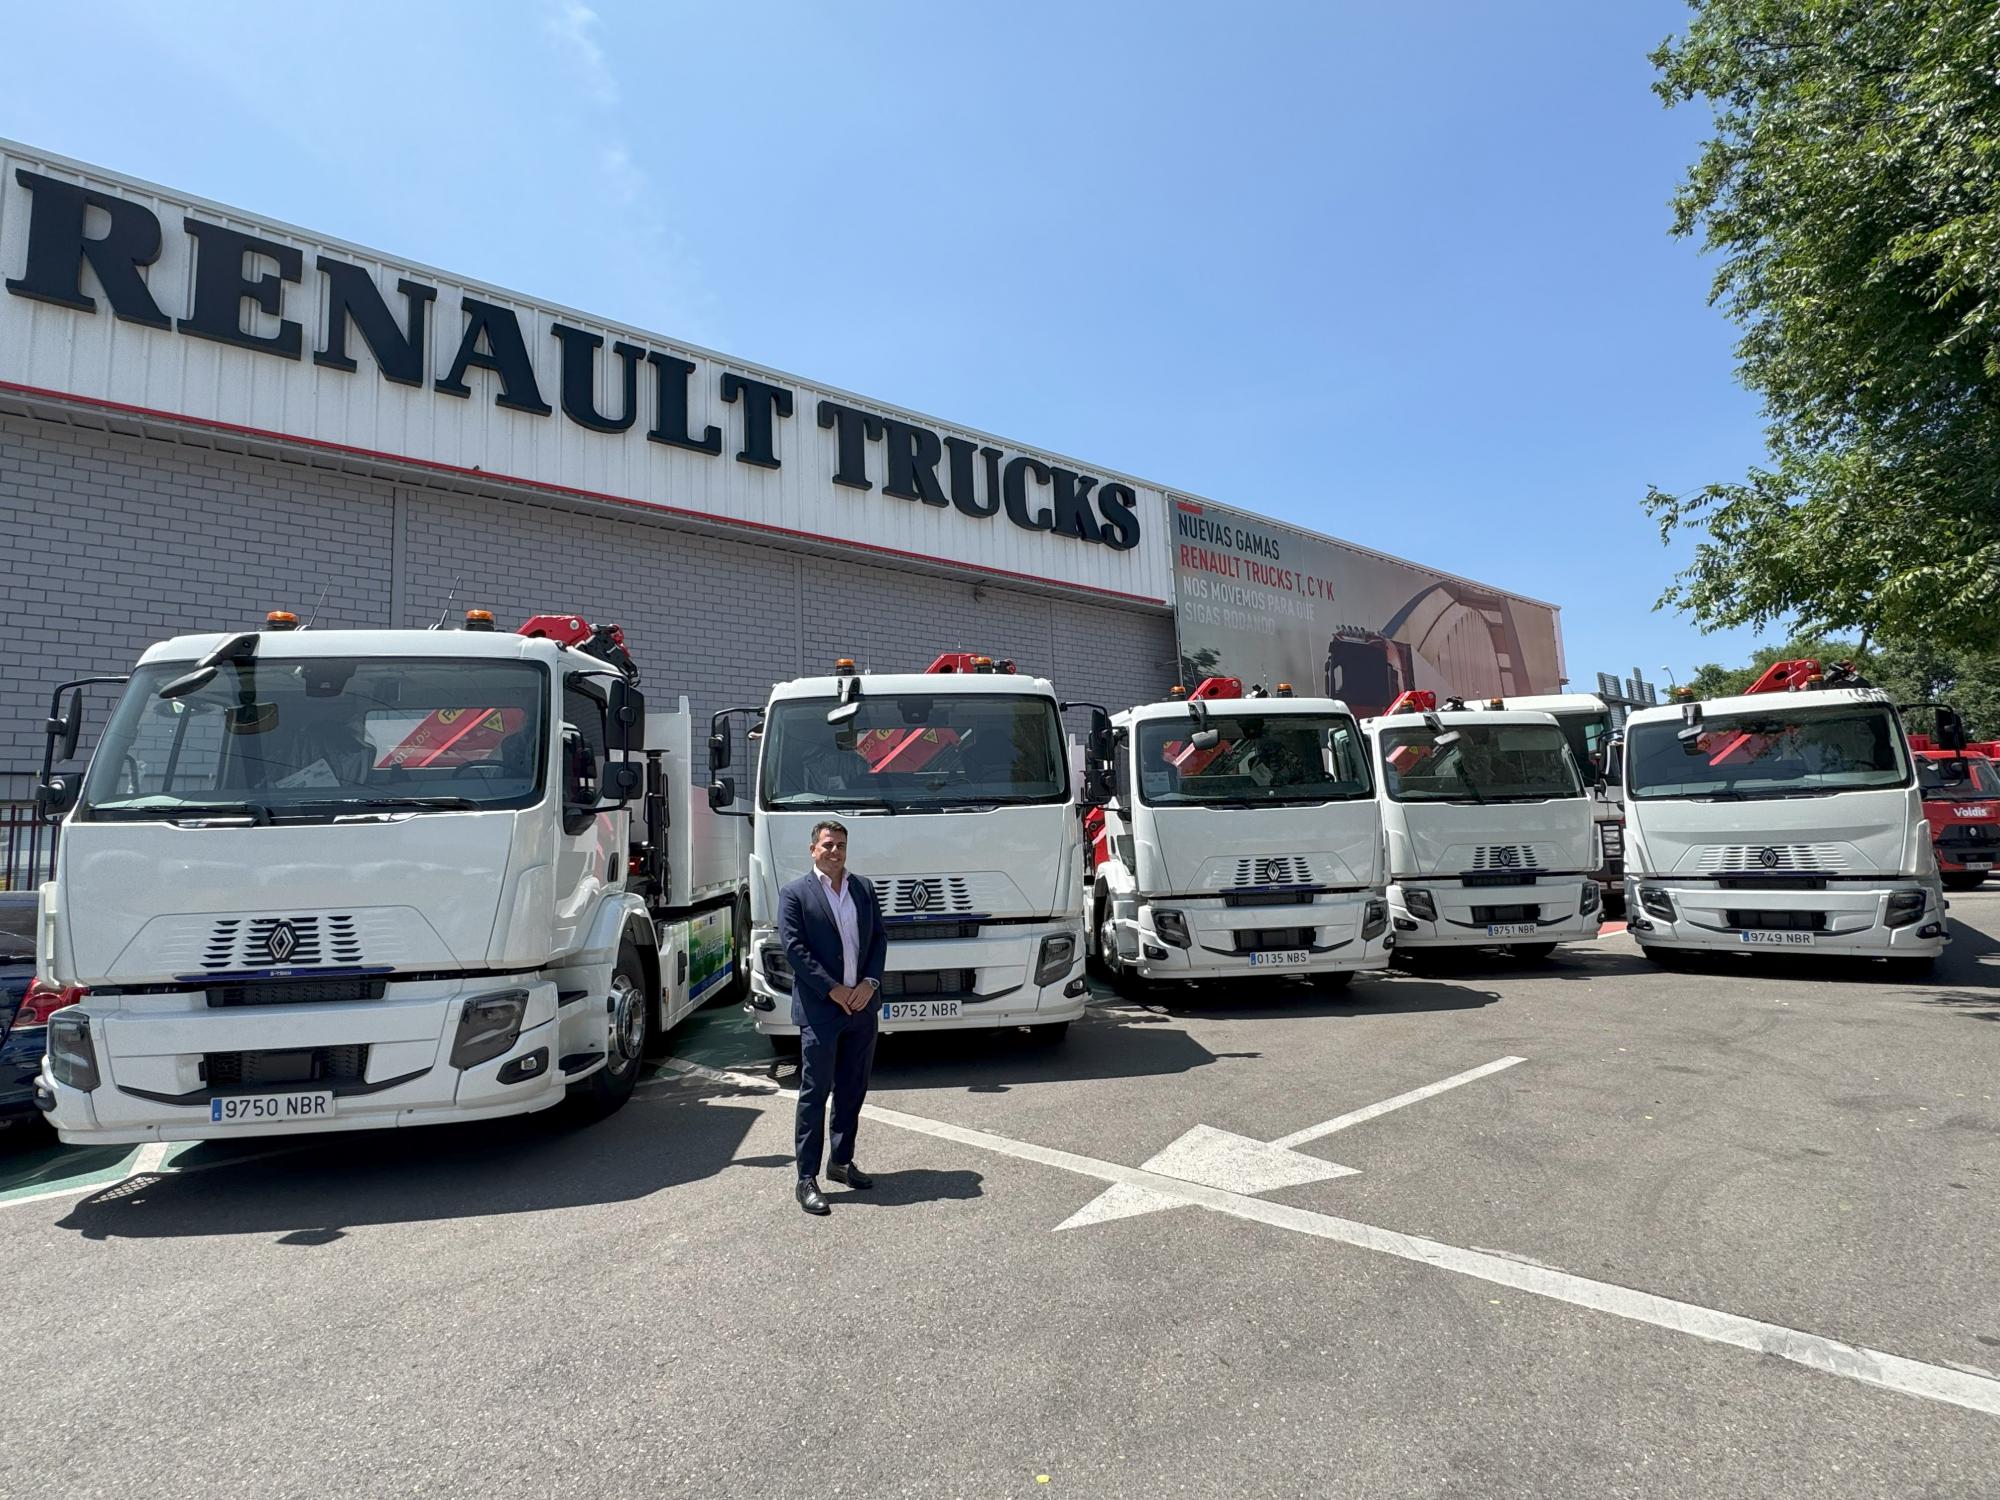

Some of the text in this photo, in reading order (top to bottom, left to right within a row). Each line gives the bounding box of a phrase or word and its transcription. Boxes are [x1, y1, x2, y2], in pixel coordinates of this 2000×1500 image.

[5, 168, 1141, 552] RENAULT TRUCKS
[1178, 513, 1280, 560] NUEVAS GAMAS
[1180, 543, 1241, 579] RENAULT
[1244, 559, 1293, 591] TRUCKS
[1307, 576, 1315, 597] C
[1316, 578, 1324, 599] Y
[1326, 581, 1335, 601] K
[1183, 575, 1208, 599] NOS
[1210, 581, 1265, 611] MOVEMOS
[1267, 594, 1295, 617] PARA
[1184, 601, 1276, 635] SIGAS RODANDO
[1493, 924, 1535, 935] 9751 NBR
[1750, 932, 1810, 944] 9749 NBR
[1257, 952, 1307, 964] 0135 NBS
[891, 1003, 958, 1018] 9752 NBR
[224, 1095, 326, 1119] 9750 NBR
